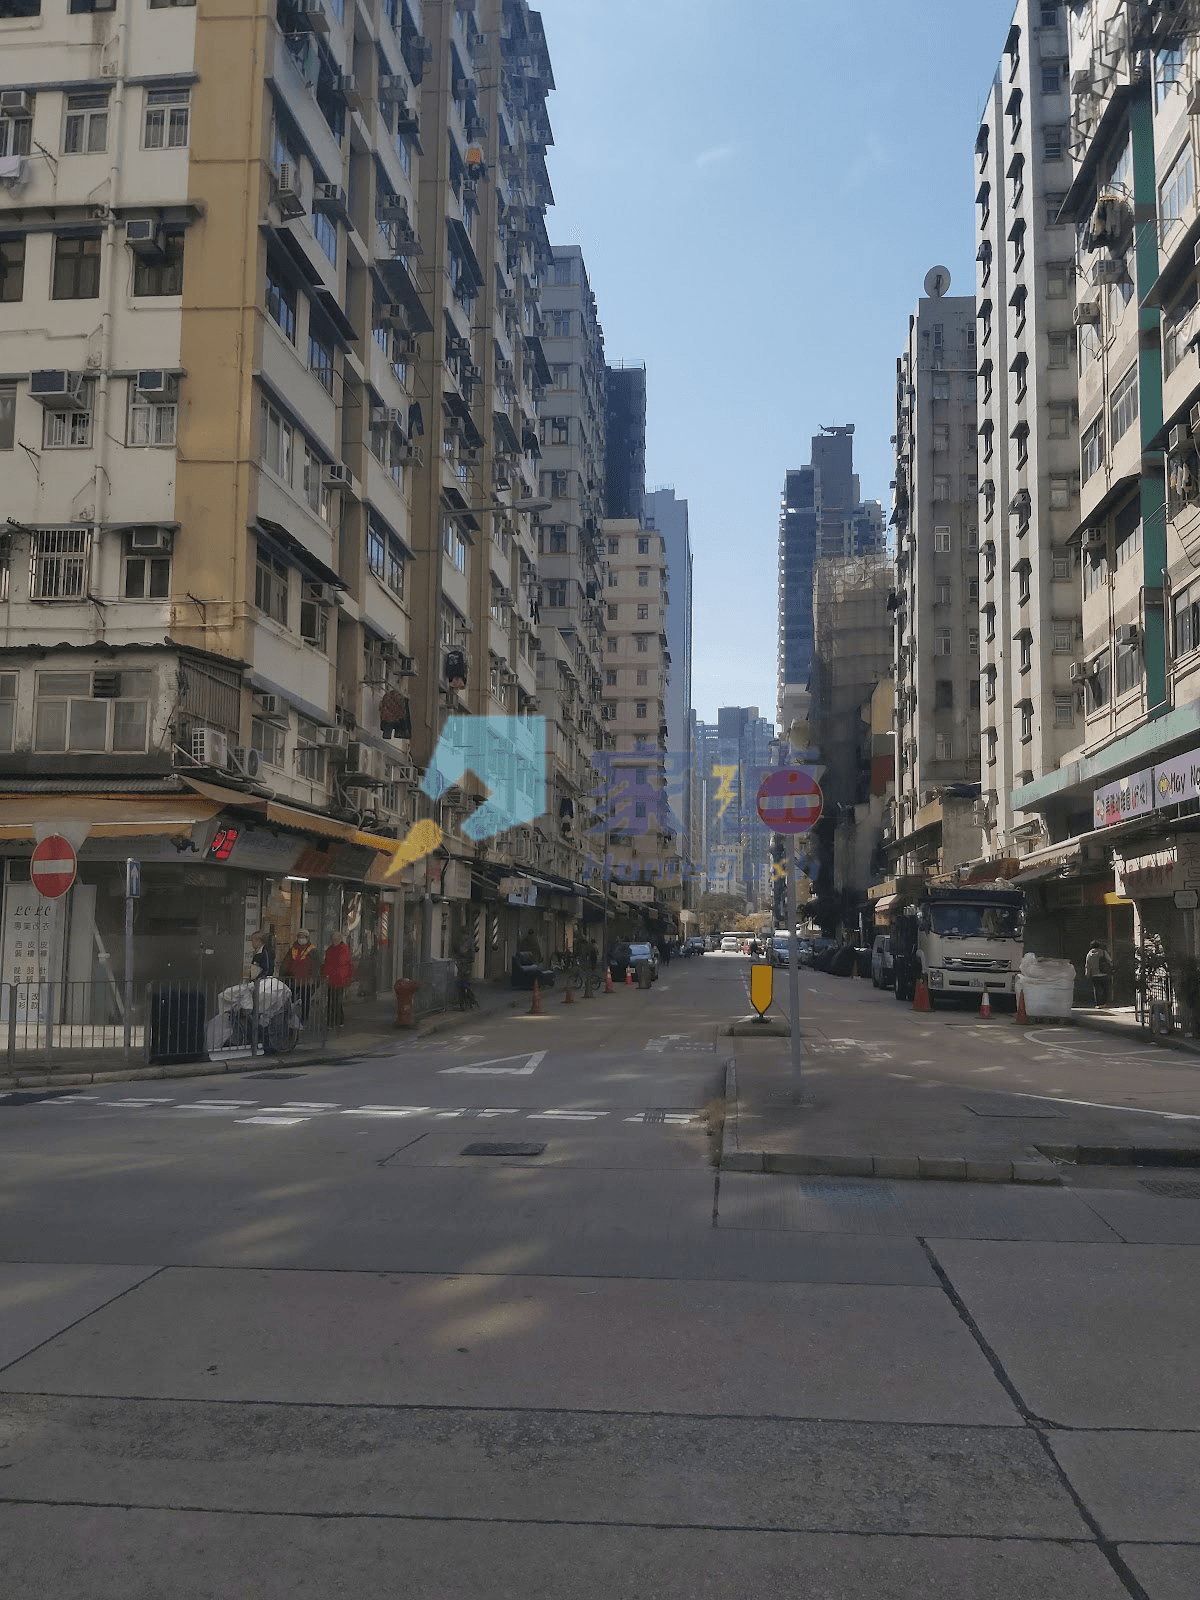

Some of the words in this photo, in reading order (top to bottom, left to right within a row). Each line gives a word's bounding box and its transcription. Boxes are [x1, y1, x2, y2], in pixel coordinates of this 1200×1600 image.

[1170, 772, 1186, 795] May
[14, 921, 50, 931] 專業改衣
